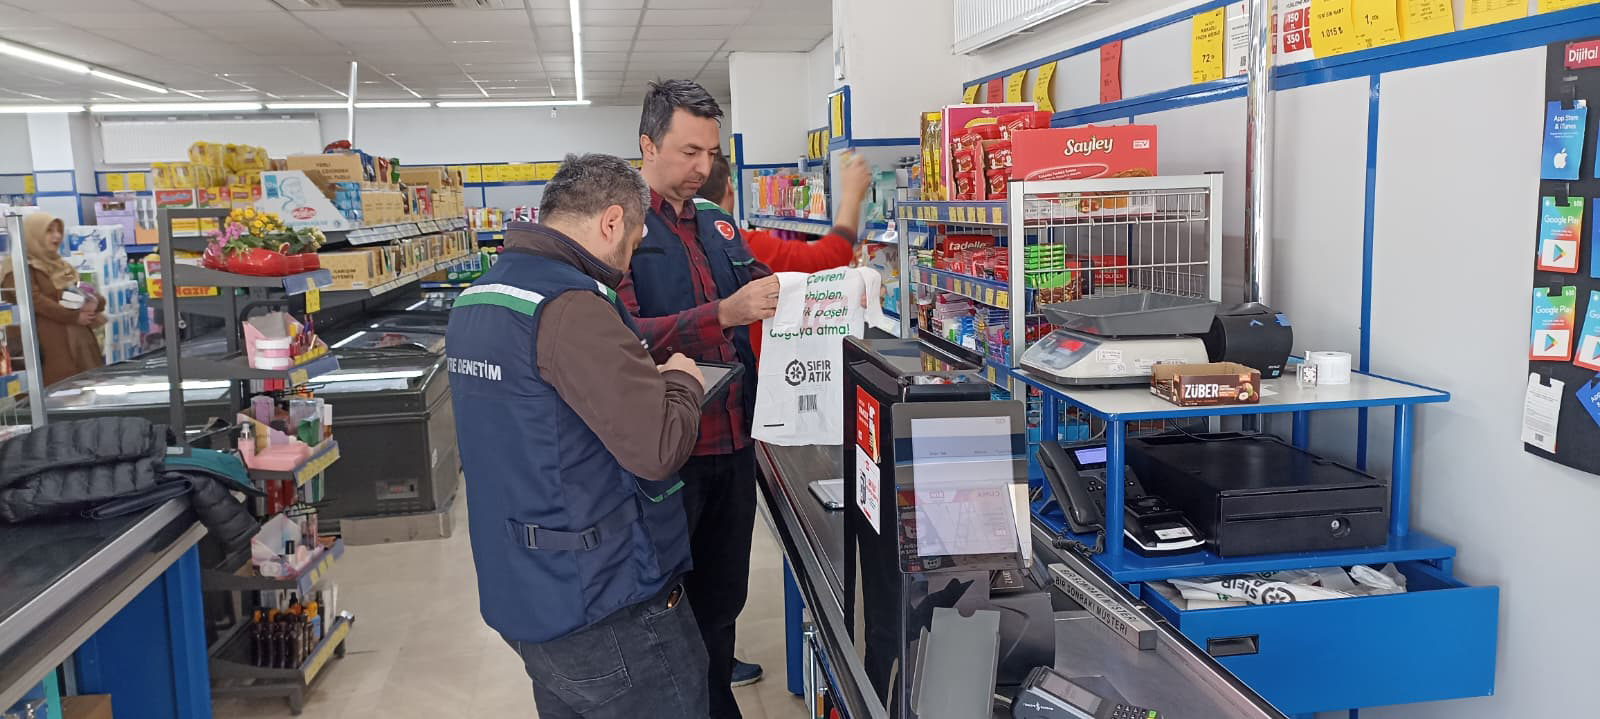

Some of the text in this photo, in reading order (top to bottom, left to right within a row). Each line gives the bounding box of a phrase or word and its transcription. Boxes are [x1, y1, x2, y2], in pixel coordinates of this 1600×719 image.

[1287, 12, 1299, 23] 150
[1286, 34, 1300, 45] 350
[1568, 46, 1598, 64] Dijital
[1553, 115, 1565, 123] App
[1063, 135, 1114, 156] Sayley
[1544, 214, 1567, 226] Google
[806, 272, 846, 287] Çevreni
[814, 306, 849, 320] poşeti
[1535, 304, 1559, 316] Google
[816, 323, 850, 336] atma!
[457, 358, 502, 381] DENETİM
[807, 360, 832, 371] SIFIR
[808, 371, 832, 383] ATIK
[1184, 384, 1219, 399] ZÜBER
